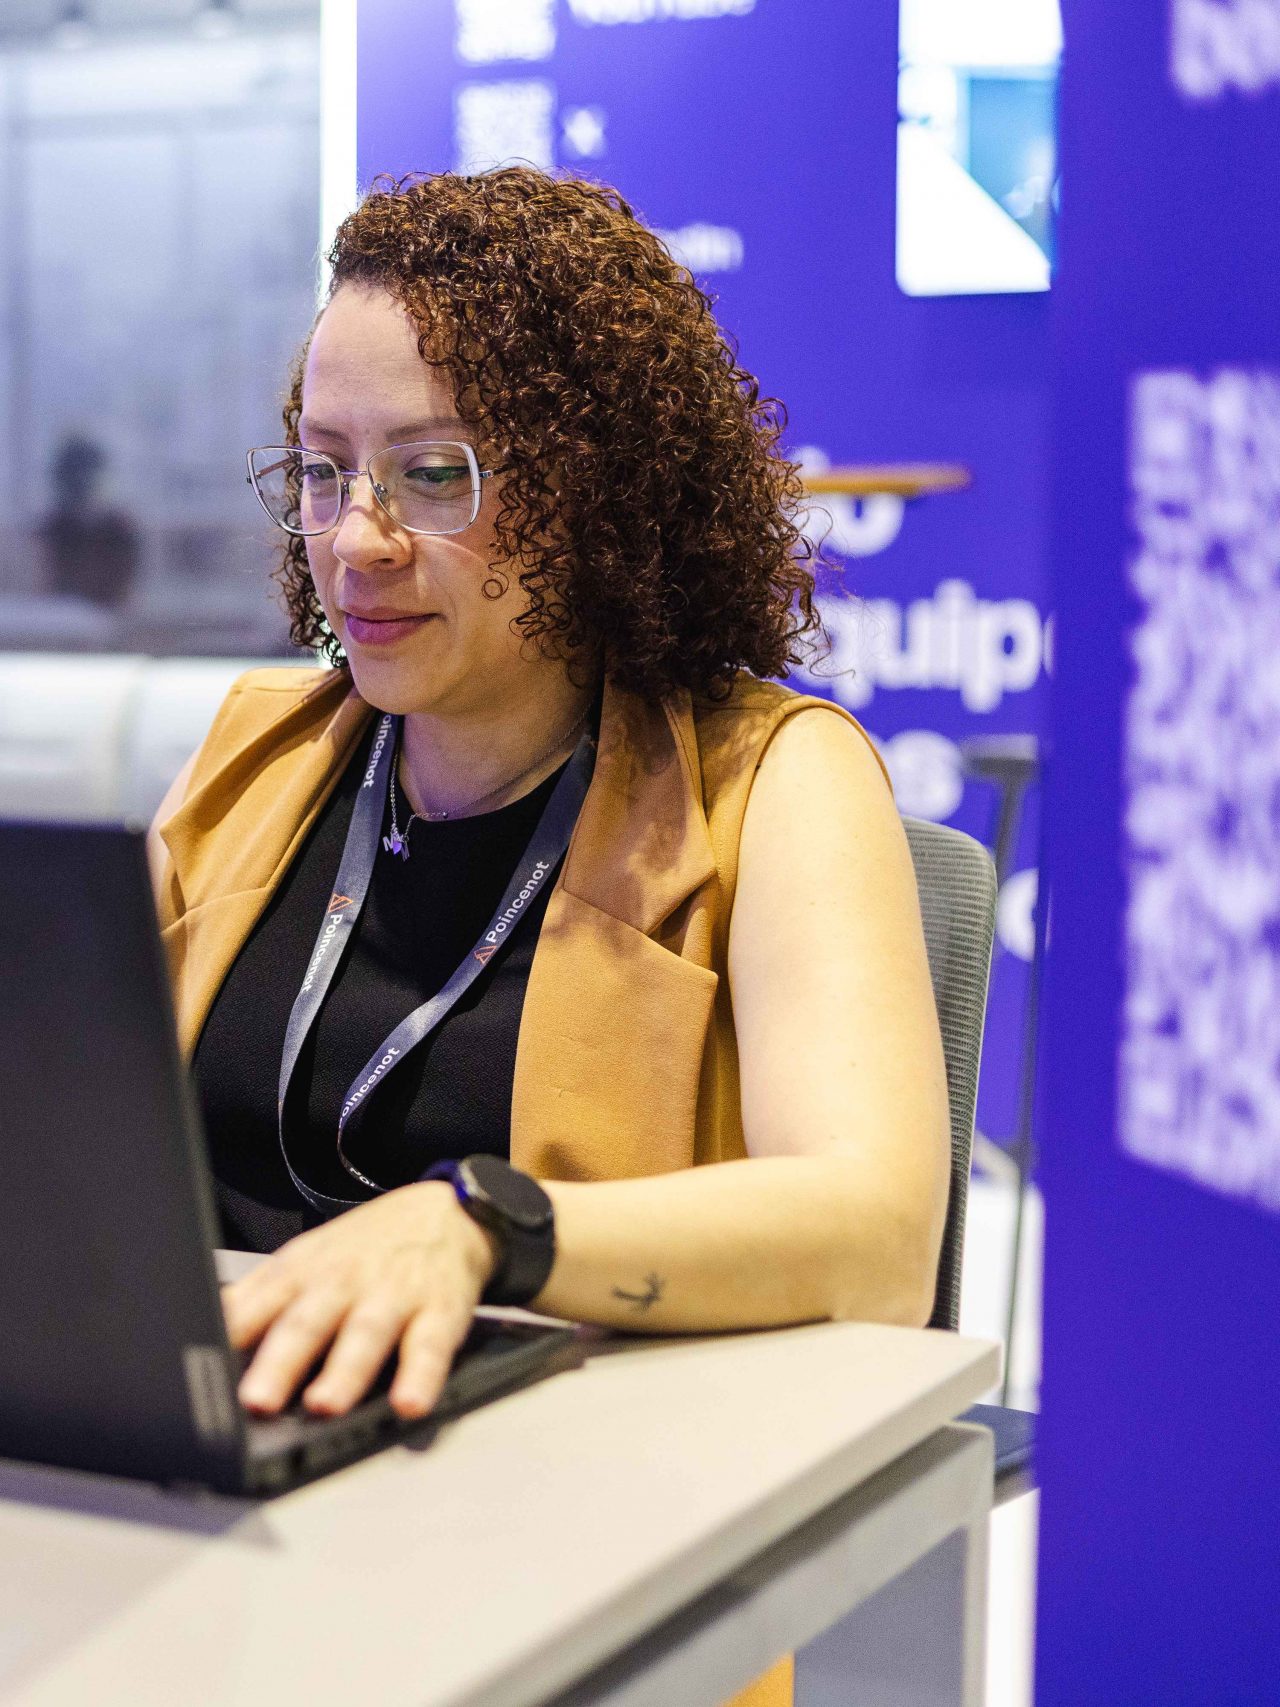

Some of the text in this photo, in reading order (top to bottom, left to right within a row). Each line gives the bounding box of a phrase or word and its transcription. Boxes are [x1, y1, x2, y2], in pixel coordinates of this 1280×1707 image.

[792, 578, 1054, 713] quip
[363, 714, 393, 788] oincenot
[485, 861, 549, 943] Poincenot
[302, 914, 343, 992] Poincenot
